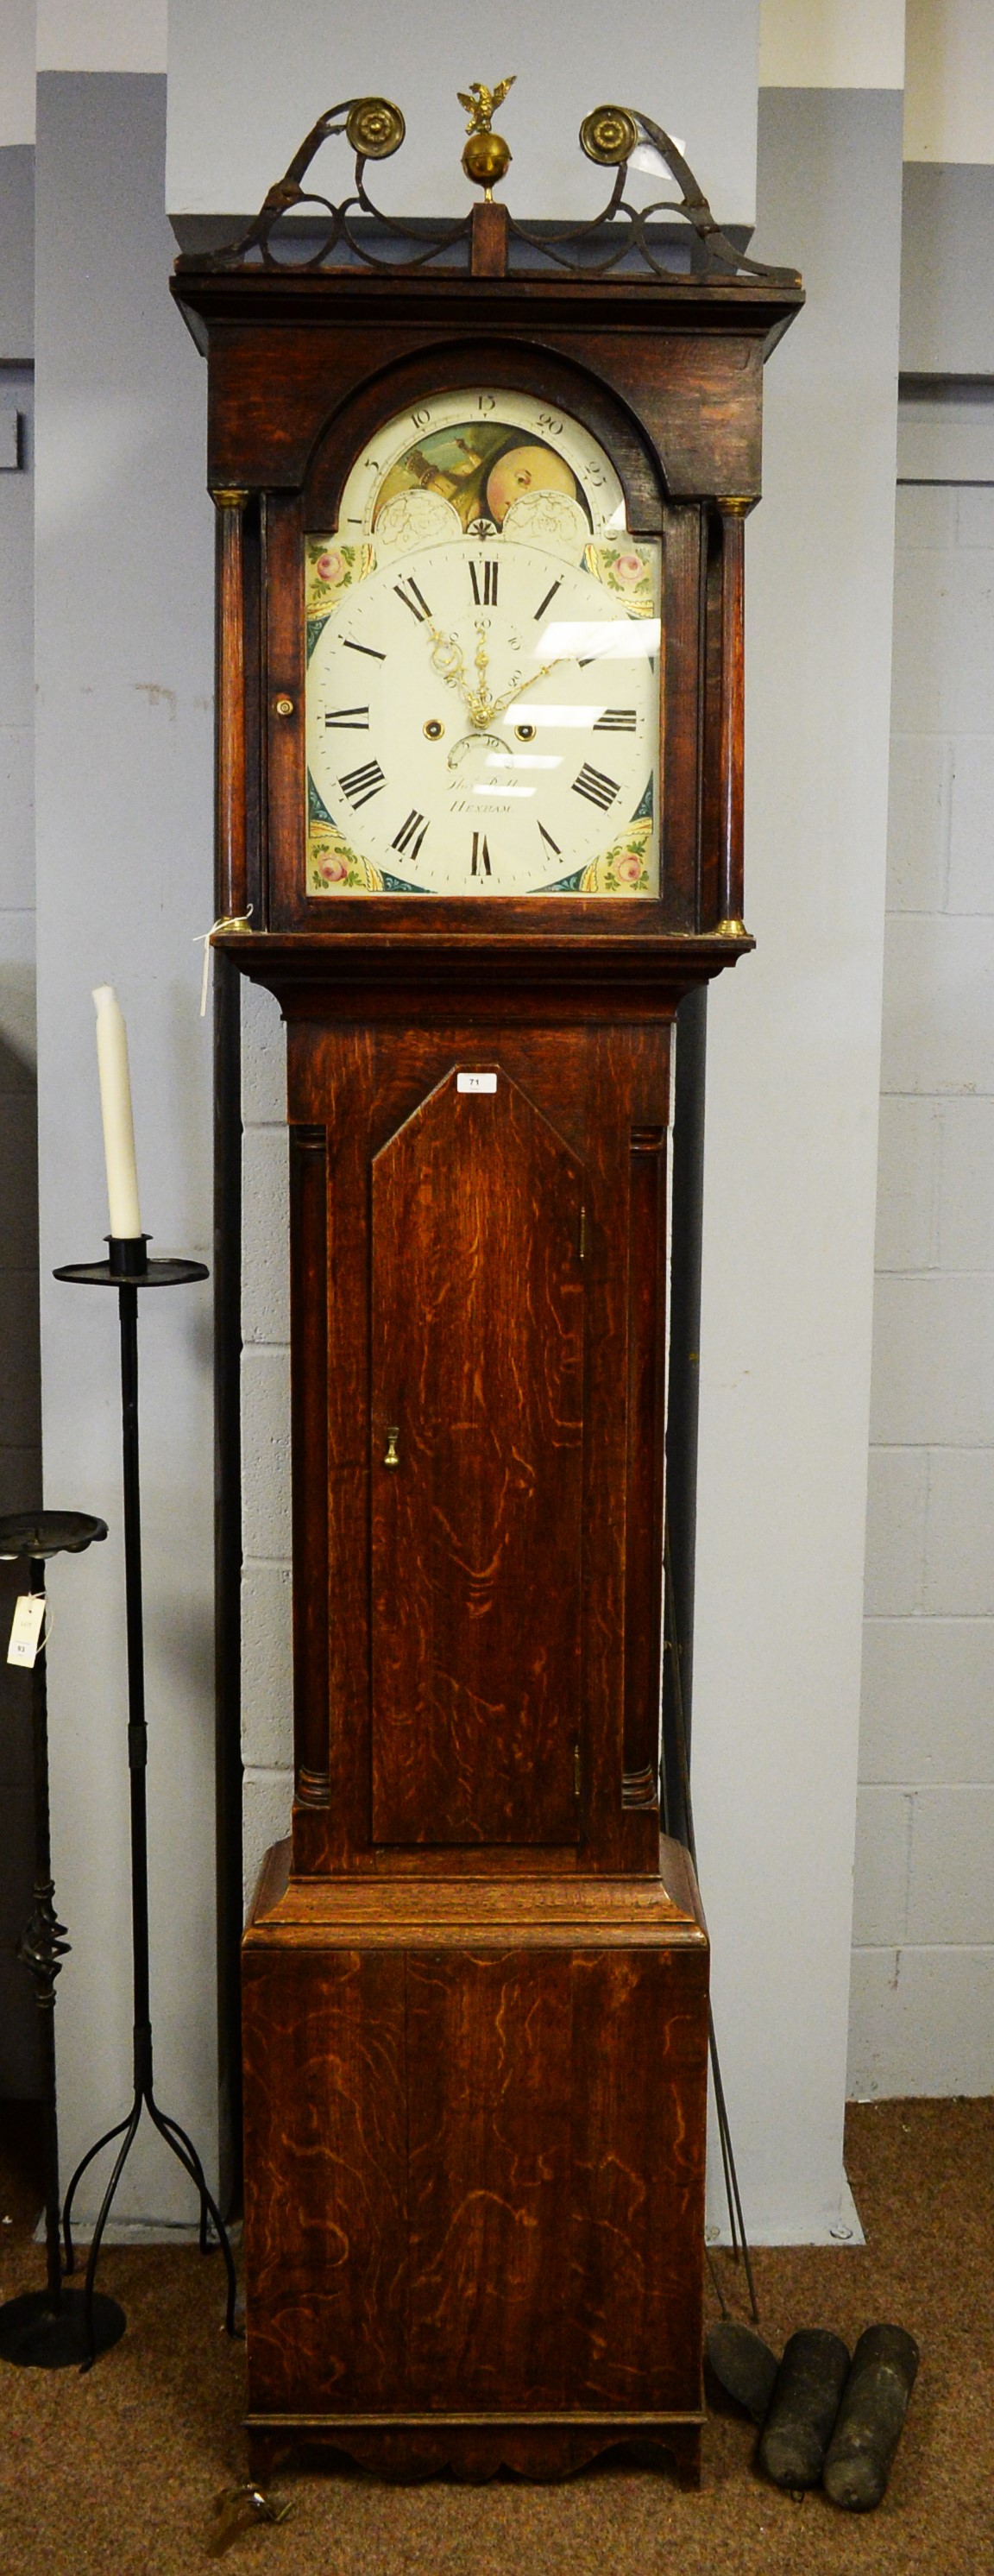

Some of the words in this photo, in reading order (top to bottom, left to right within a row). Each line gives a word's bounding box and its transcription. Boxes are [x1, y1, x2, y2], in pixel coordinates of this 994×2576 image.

[478, 396, 496, 411] 15
[410, 408, 431, 429] 10
[537, 413, 564, 435] 20
[365, 460, 381, 476] 5
[587, 461, 607, 488] 25
[474, 617, 492, 629] 60
[507, 637, 522, 651] 10
[508, 669, 523, 688] 20
